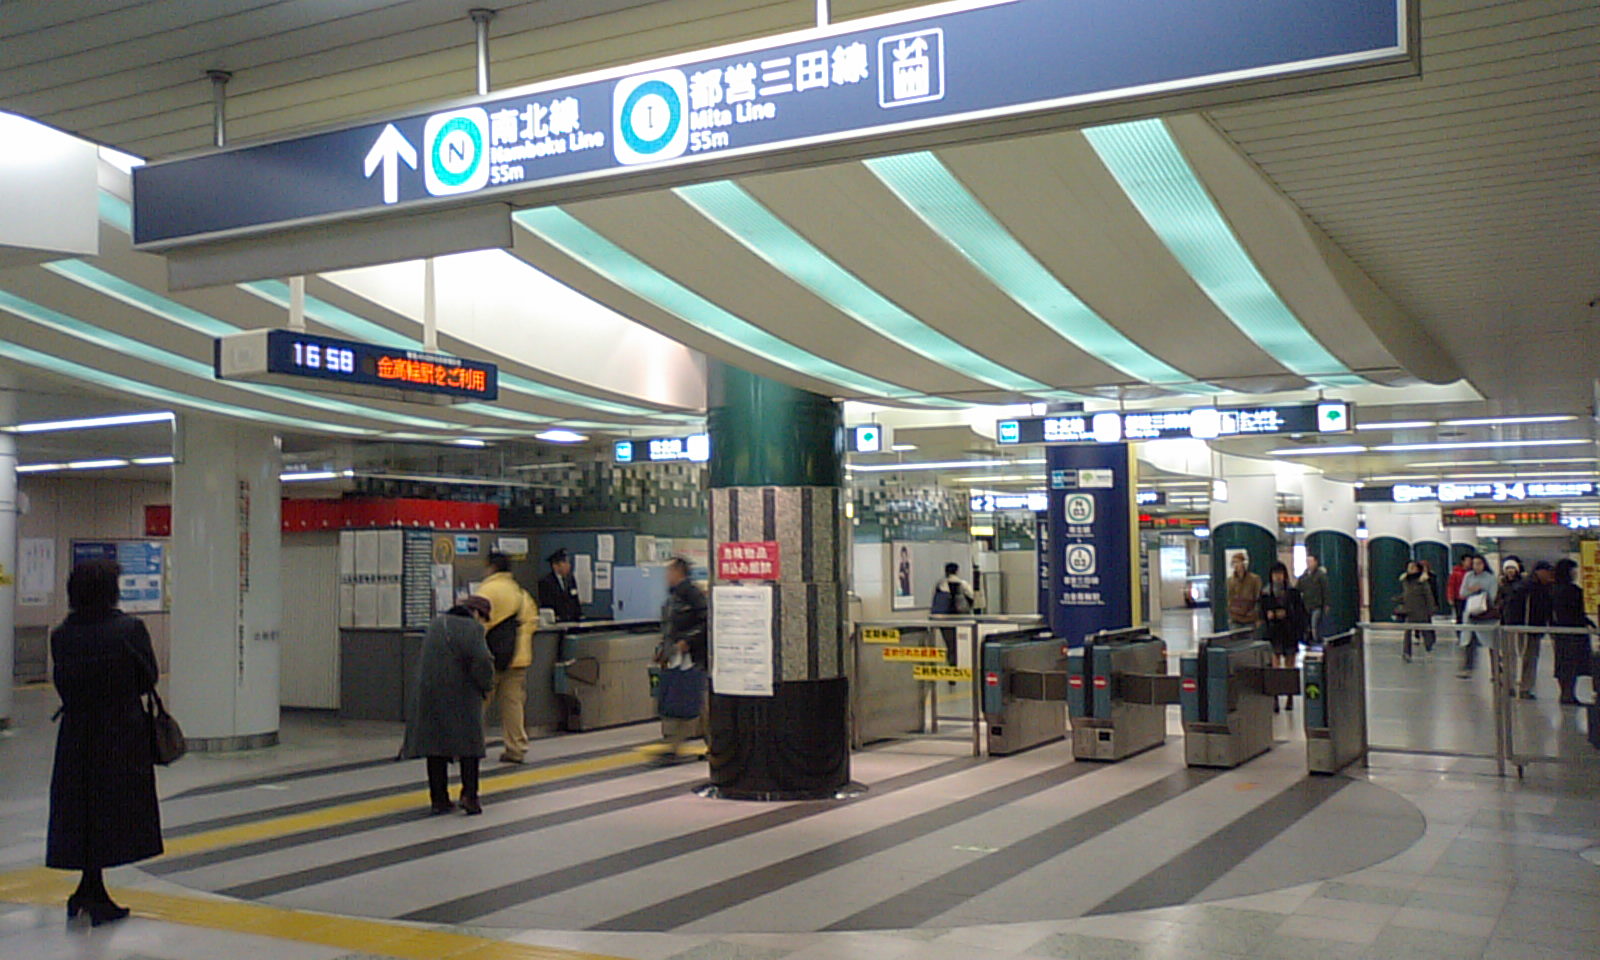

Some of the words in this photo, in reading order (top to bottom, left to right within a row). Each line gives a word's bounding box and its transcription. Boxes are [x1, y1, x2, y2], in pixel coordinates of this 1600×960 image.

[690, 42, 869, 110] 都営三田線
[490, 97, 580, 146] 南北線
[690, 108, 732, 130] Mita
[736, 102, 776, 123] Line
[449, 139, 465, 163] N
[569, 131, 605, 151] Line
[690, 131, 729, 151] 55m
[490, 165, 525, 185] 55m
